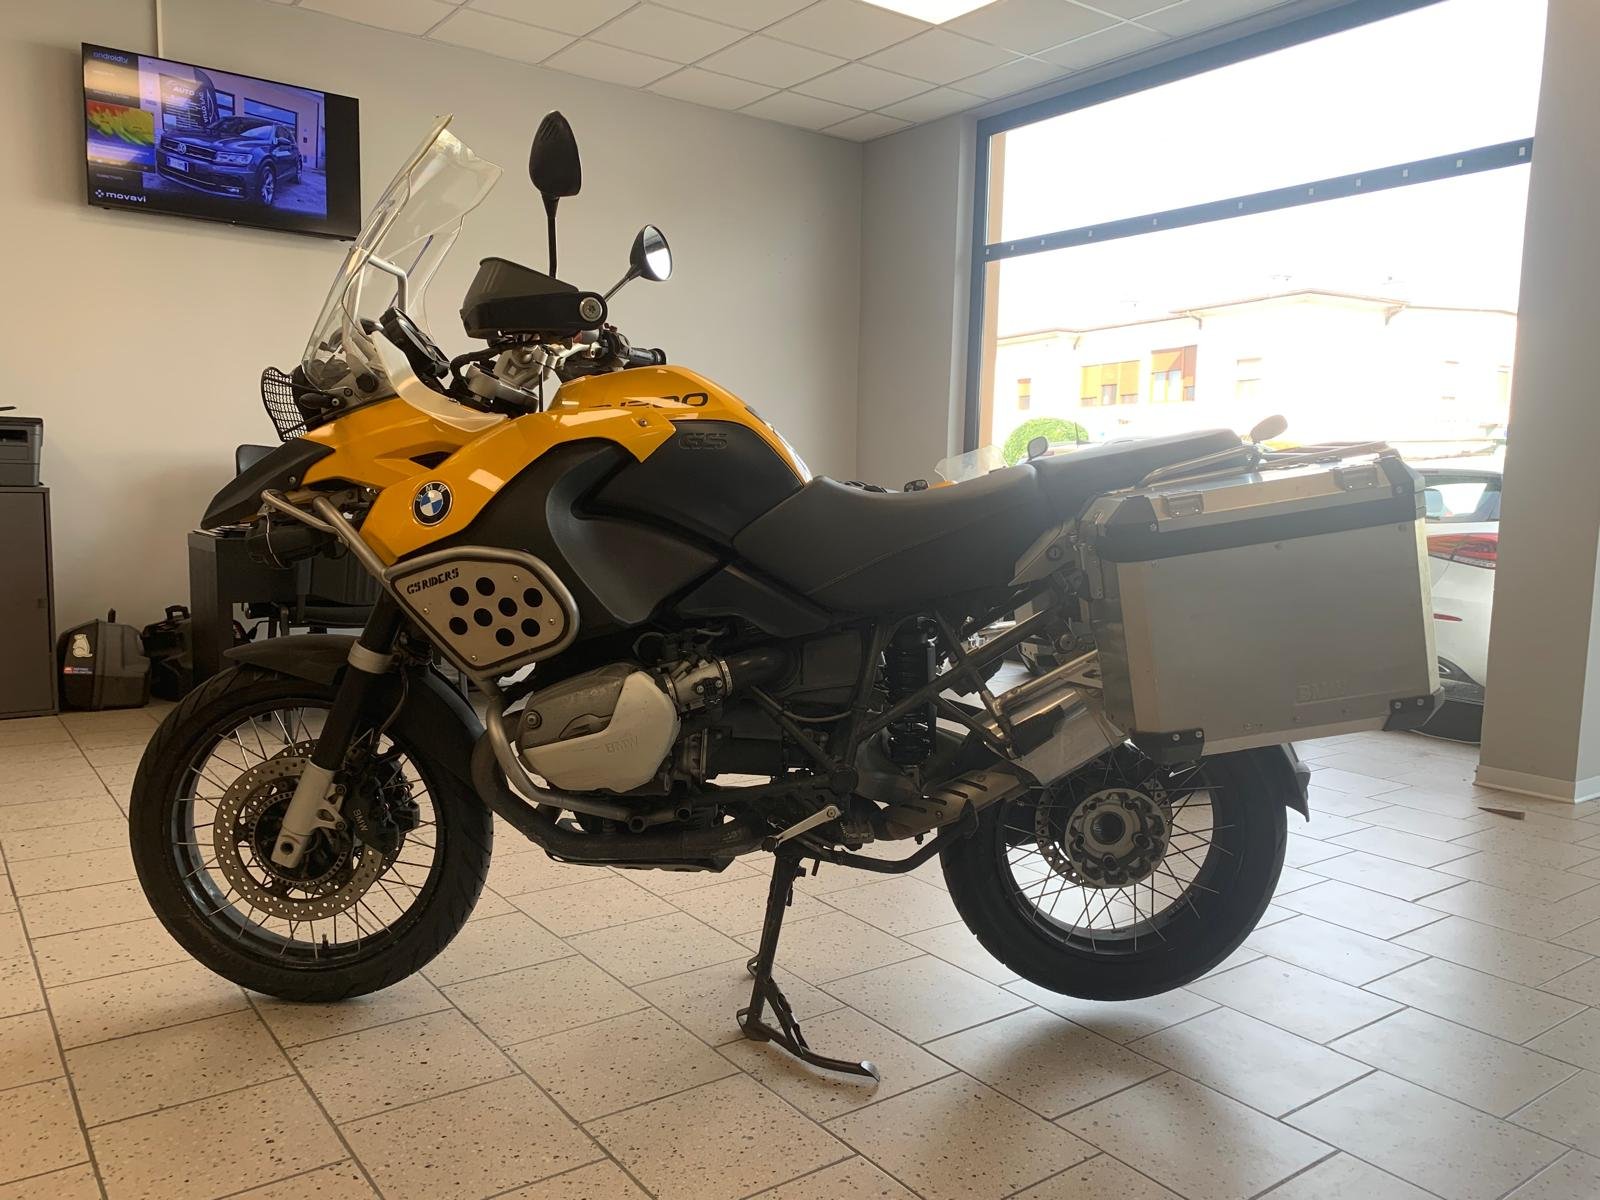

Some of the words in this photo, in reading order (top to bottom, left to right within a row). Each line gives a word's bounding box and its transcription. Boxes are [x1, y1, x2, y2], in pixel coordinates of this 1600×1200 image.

[173, 86, 195, 96] AUTO
[105, 191, 147, 203] movavi
[678, 432, 729, 450] GS
[406, 581, 421, 595] GS
[422, 567, 459, 590] RIDERS
[607, 735, 639, 753] BMW
[353, 809, 368, 831] BMW
